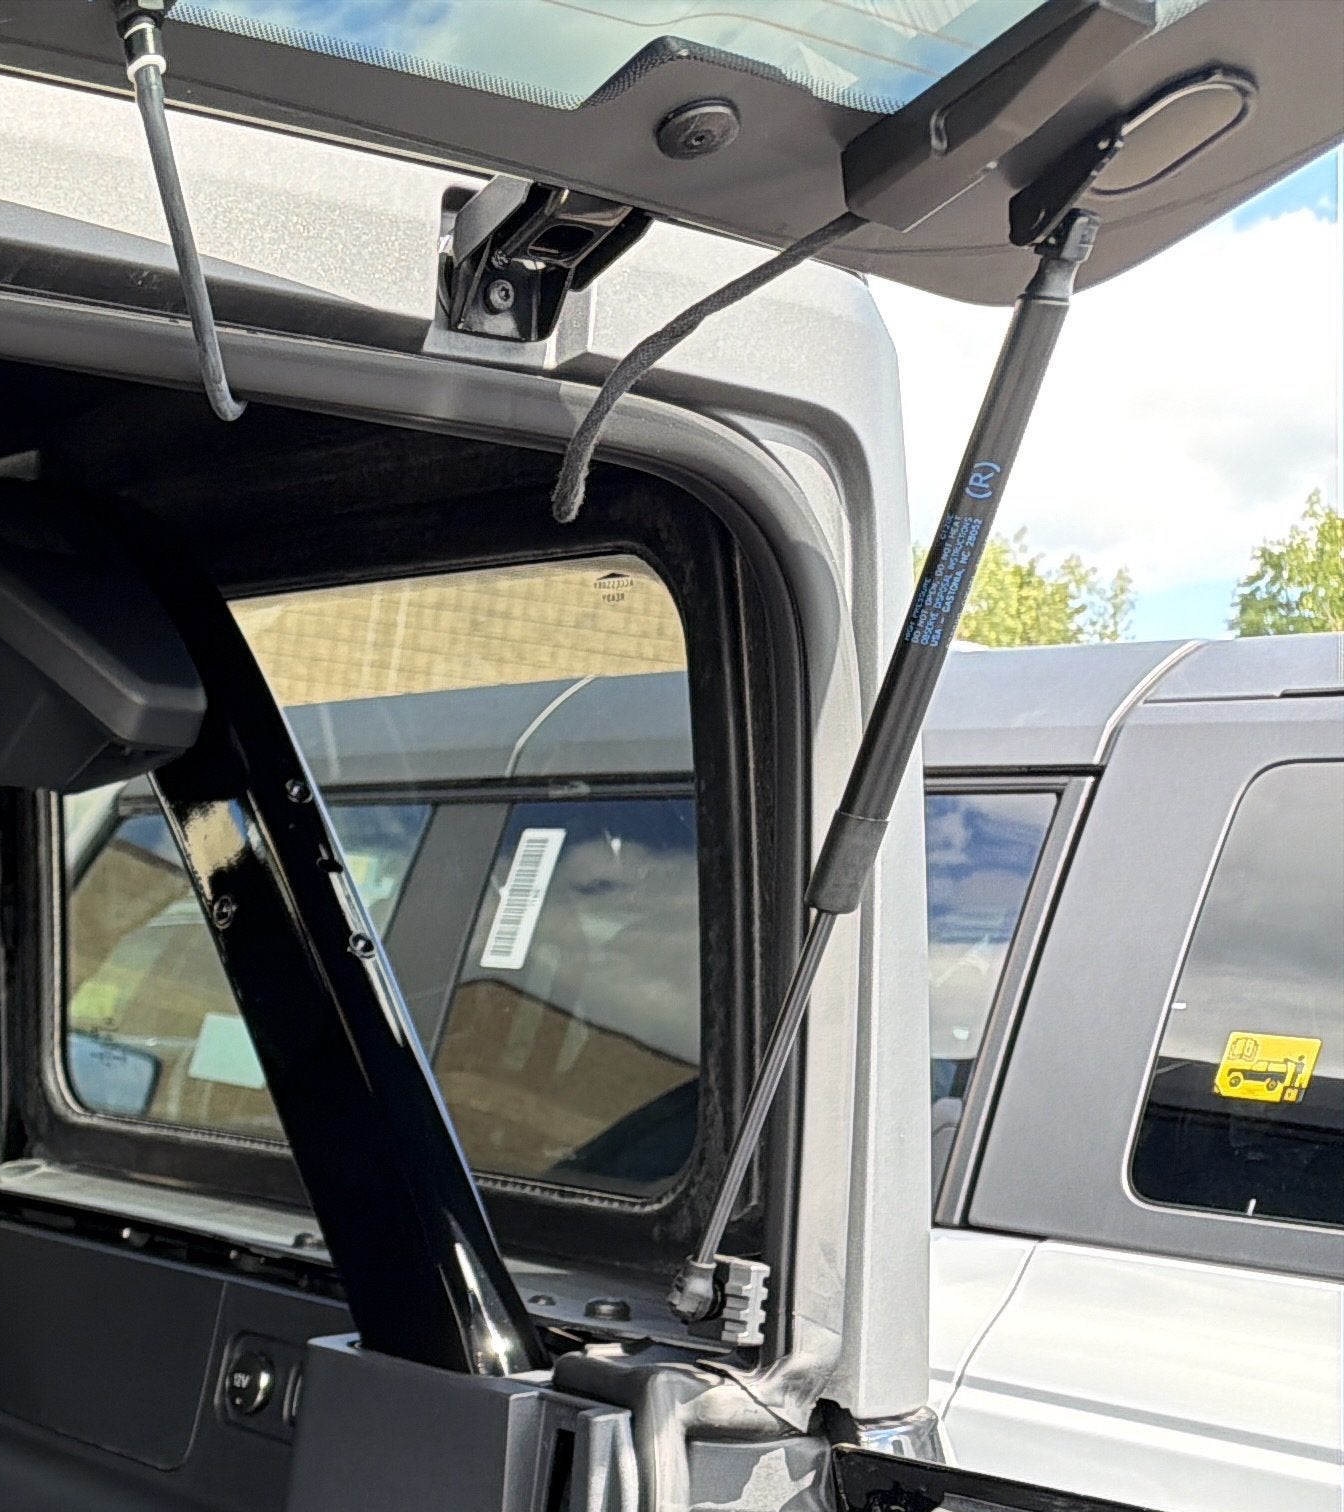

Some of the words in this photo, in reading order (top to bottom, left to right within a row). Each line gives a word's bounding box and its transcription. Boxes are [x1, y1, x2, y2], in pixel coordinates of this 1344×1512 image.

[965, 461, 1001, 500] (R)
[911, 629, 921, 643] DO
[916, 608, 929, 627] NOT
[933, 562, 945, 577] DO
[940, 542, 952, 561] NOT
[947, 514, 962, 539] HEAT
[911, 576, 931, 618] PRESSURE
[919, 610, 938, 645] OBSERVE
[932, 573, 952, 609] DISPOSAL
[947, 516, 972, 569] INSTRUCTIONS
[929, 627, 942, 647] USA
[959, 550, 970, 564] NC
[965, 517, 982, 547] 28052
